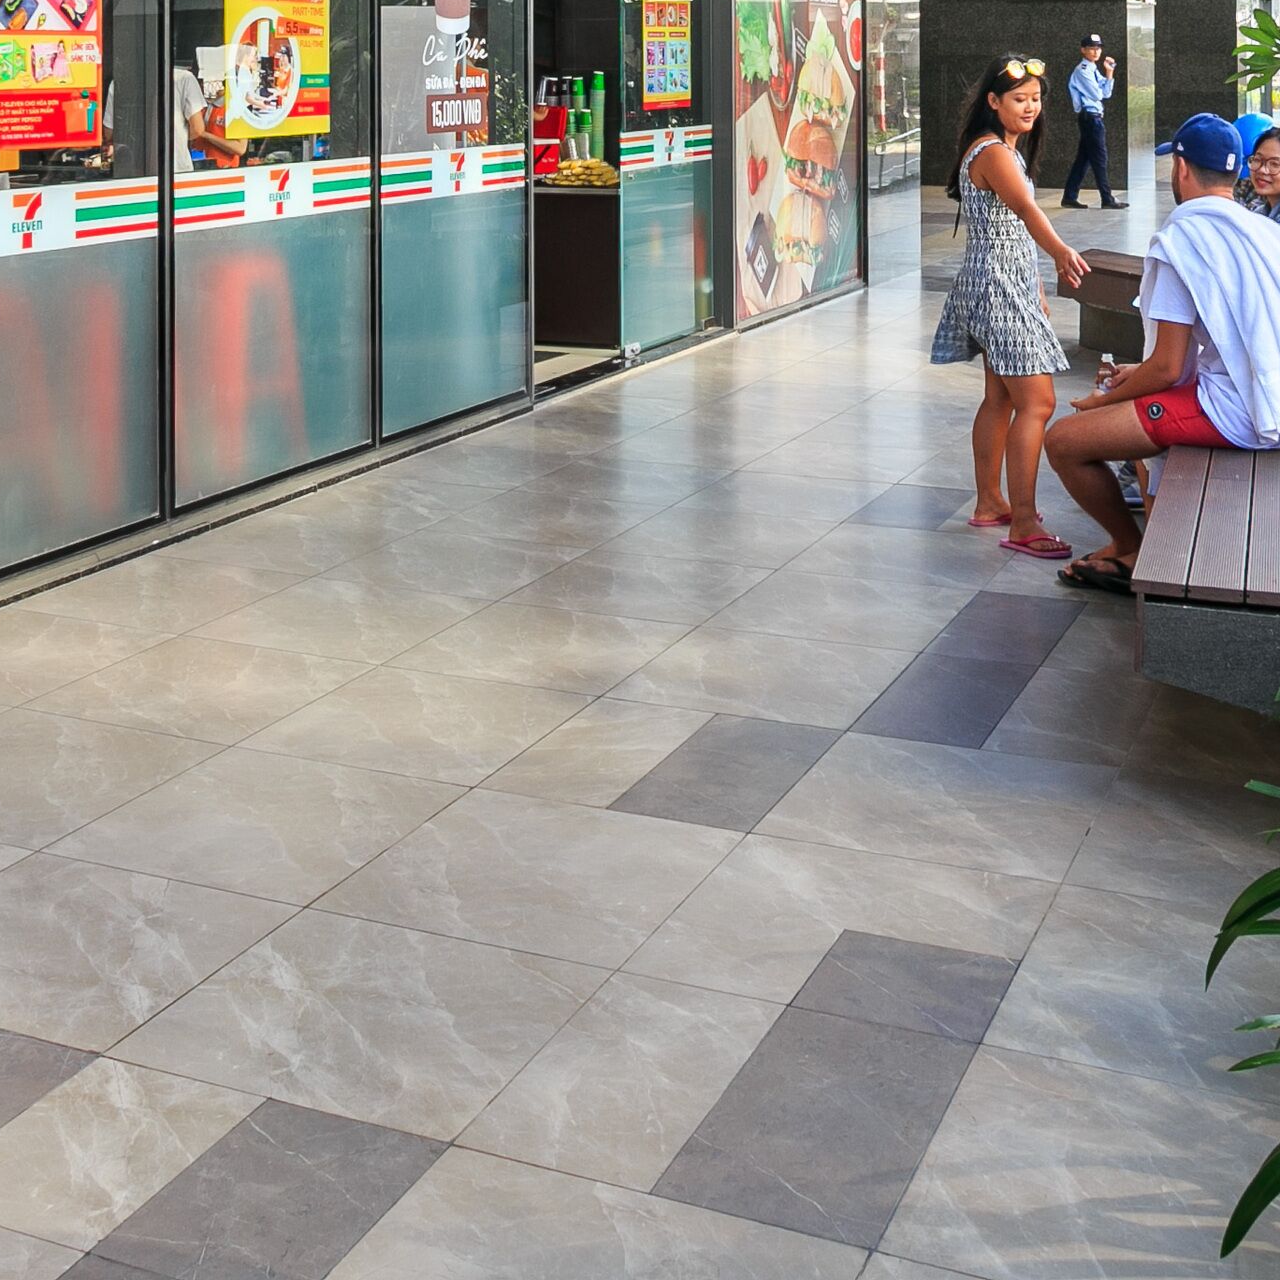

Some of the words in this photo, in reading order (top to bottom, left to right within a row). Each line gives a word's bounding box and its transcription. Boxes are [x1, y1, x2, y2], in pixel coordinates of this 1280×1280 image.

[292, 6, 324, 17] PART-TIME
[286, 22, 298, 35] 5,5
[422, 34, 448, 66] Cà
[454, 33, 489, 68] Phê
[431, 100, 462, 128] 15,000
[463, 99, 482, 125] VNĐ
[270, 168, 290, 215] 7
[13, 192, 42, 249] 7
